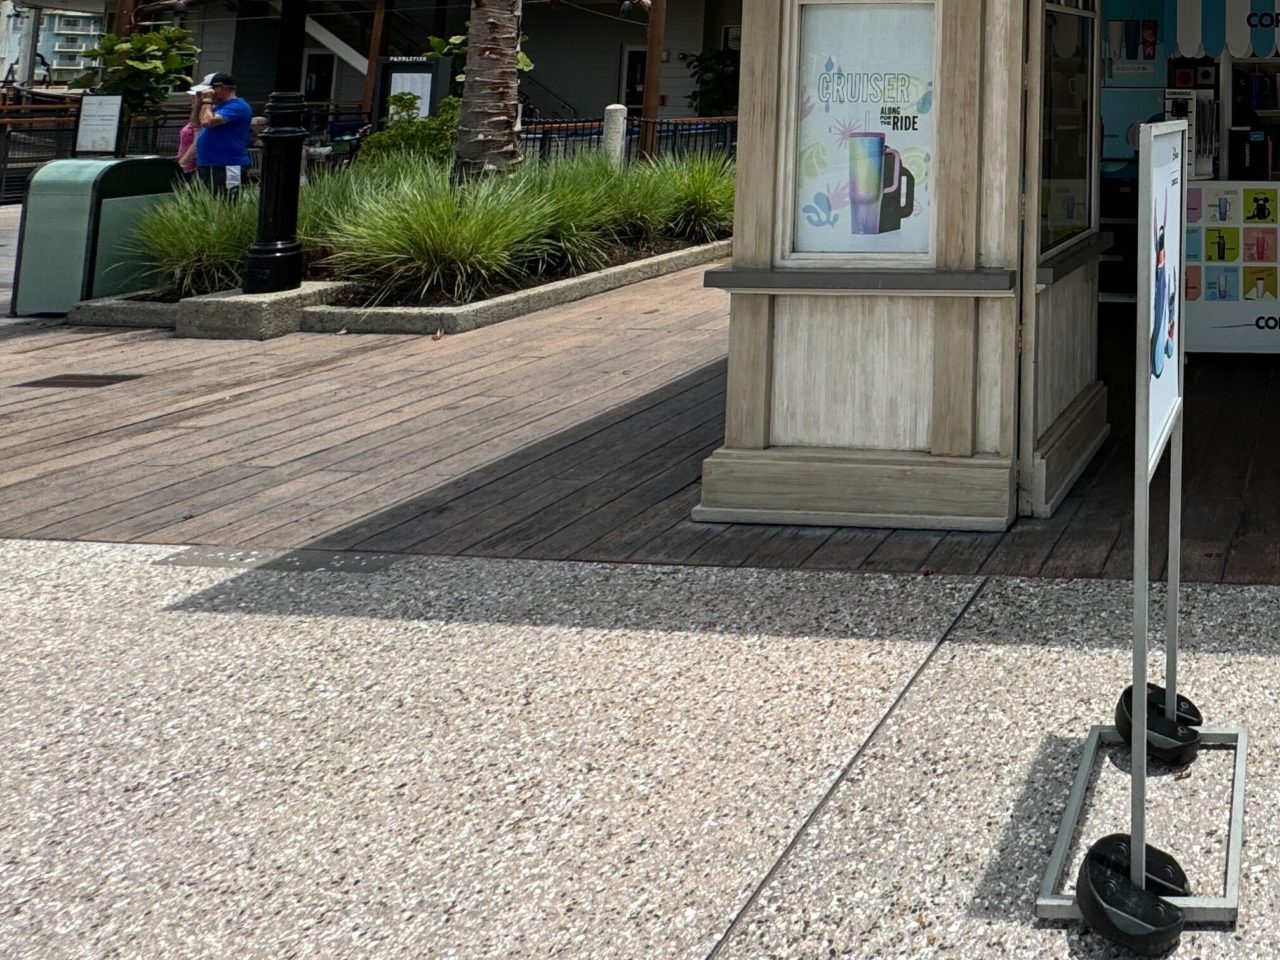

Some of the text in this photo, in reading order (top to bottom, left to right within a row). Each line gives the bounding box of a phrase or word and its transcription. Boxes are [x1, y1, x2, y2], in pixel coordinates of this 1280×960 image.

[818, 73, 910, 103] CRUISER
[880, 106, 901, 115] ALONG
[892, 116, 919, 131] RIDE
